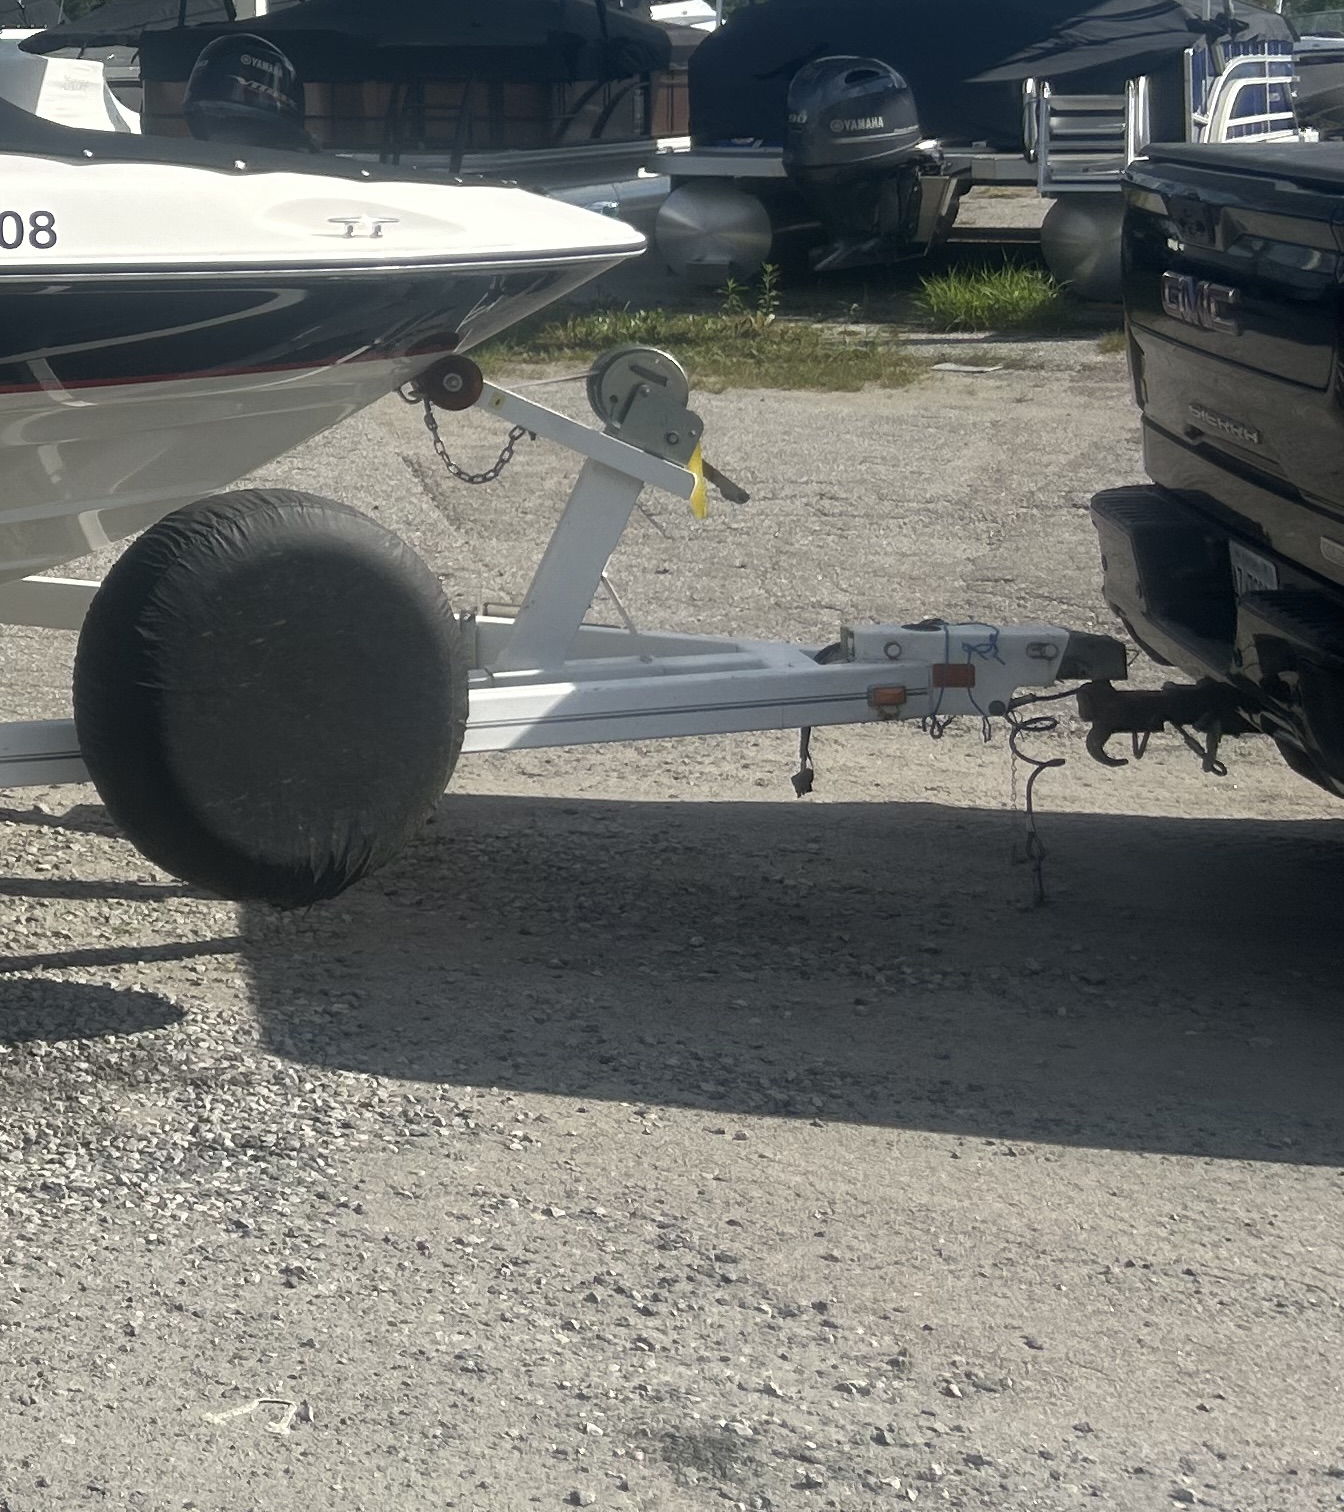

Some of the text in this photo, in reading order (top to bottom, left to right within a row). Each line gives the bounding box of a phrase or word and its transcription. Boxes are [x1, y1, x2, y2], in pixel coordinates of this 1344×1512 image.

[252, 57, 284, 78] YAMAHA
[844, 116, 884, 131] YAMAHA
[1162, 270, 1241, 336] GMC
